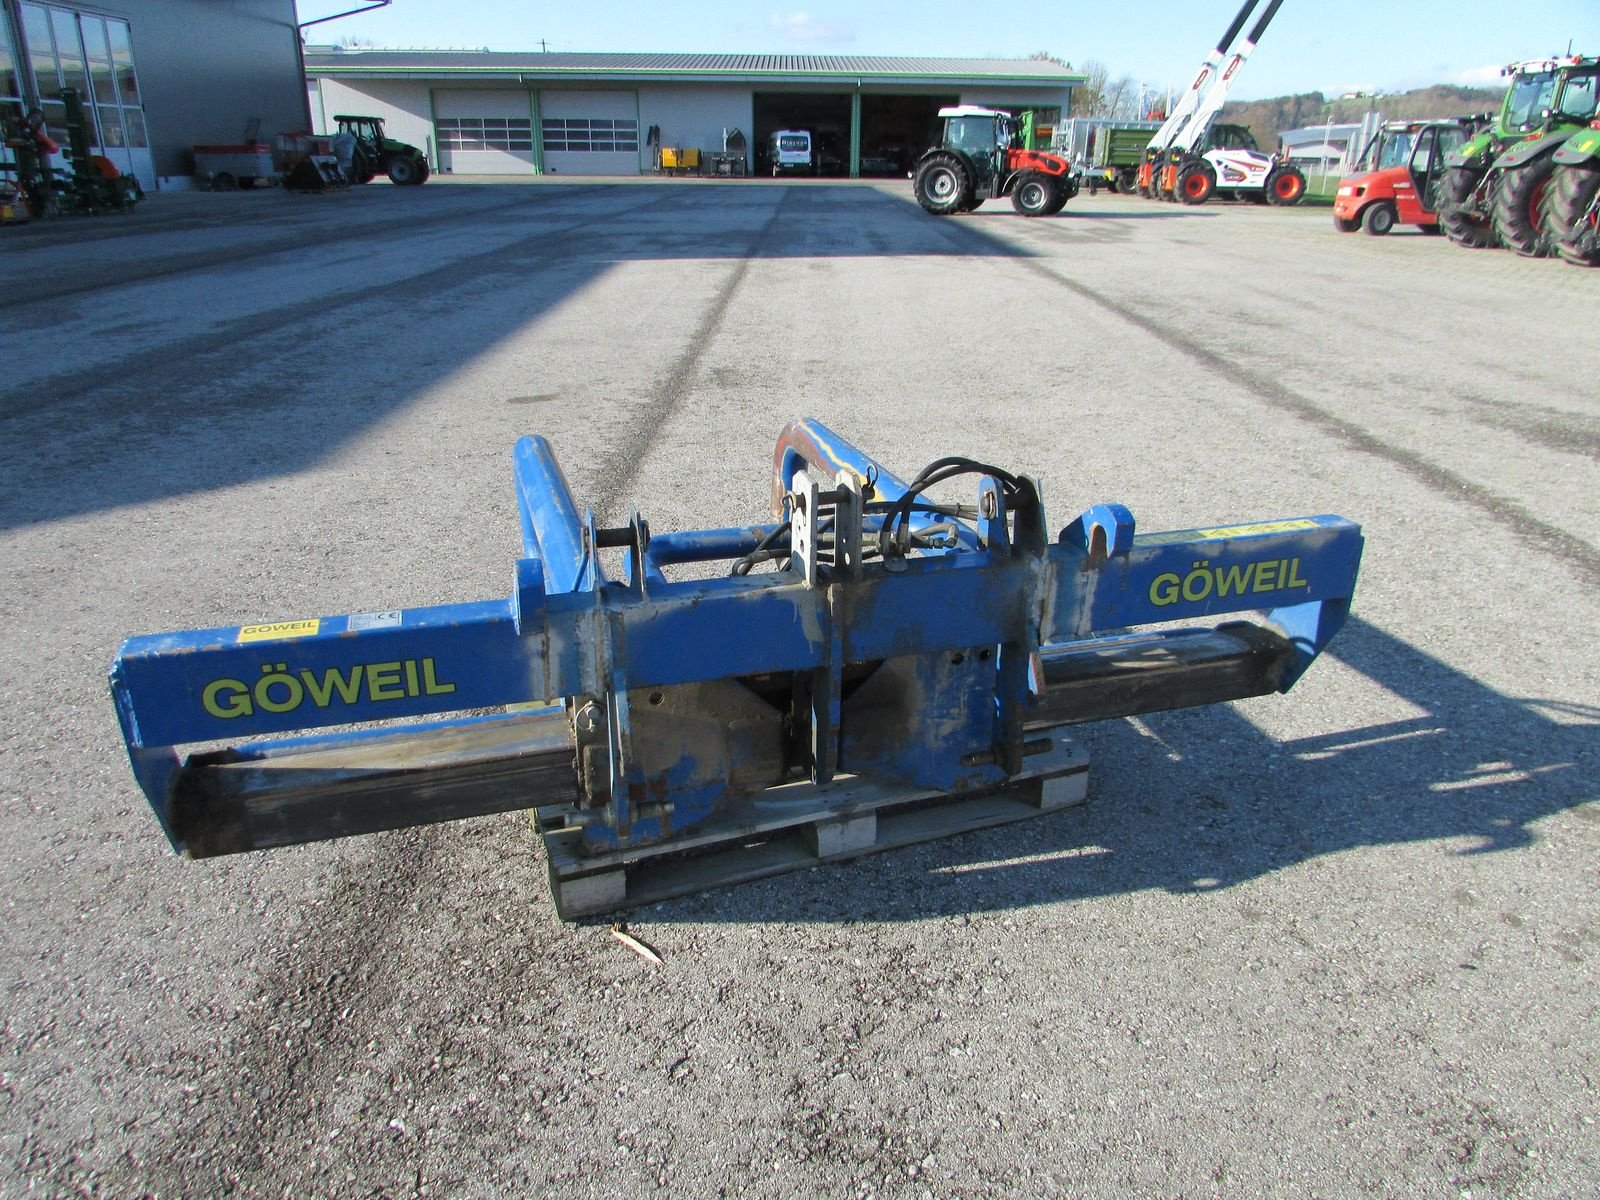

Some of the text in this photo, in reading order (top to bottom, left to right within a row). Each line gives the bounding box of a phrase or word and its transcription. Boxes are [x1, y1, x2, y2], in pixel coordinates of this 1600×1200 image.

[1149, 558, 1307, 606] GÖWEIL
[243, 621, 316, 635] GÖWEIL
[202, 657, 456, 719] GÖWEIL
